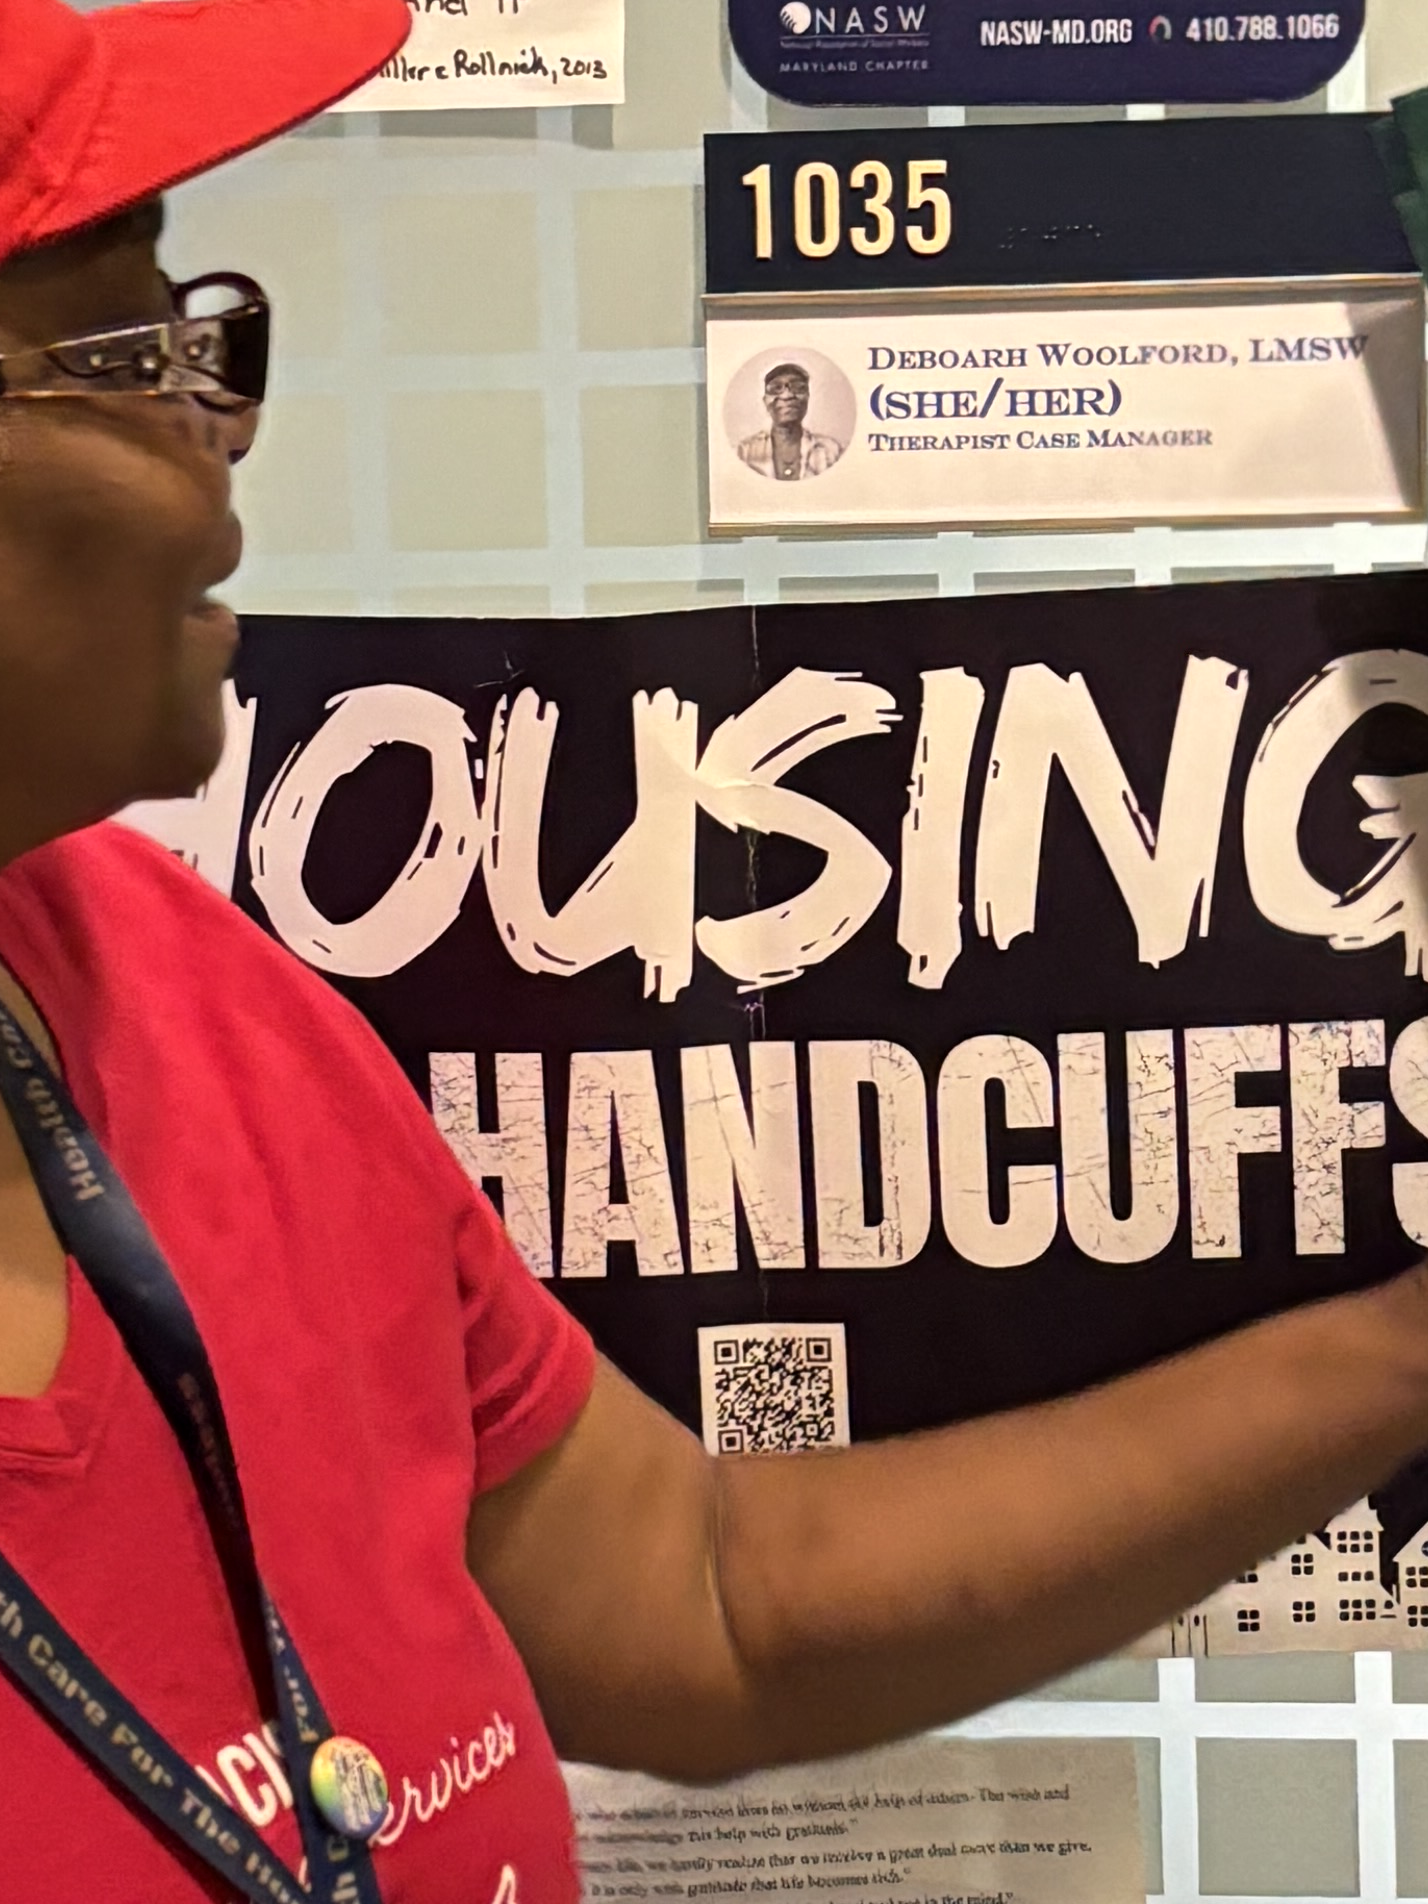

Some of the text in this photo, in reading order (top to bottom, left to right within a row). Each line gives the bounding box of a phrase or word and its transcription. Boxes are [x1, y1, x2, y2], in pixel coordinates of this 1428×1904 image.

[816, 4, 925, 34] NASW
[980, 15, 1340, 48] NASW-MD.ORG 410.788.1066
[560, 56, 607, 81] 2013
[741, 158, 954, 261] 1035
[868, 334, 1369, 371] DEBOARH WOOLFORD, LMSW
[870, 377, 1123, 422] (SHE/HER)
[868, 428, 1214, 453] THERAPIST CASE MANAGER
[28, 1632, 109, 1729] Care
[109, 1721, 174, 1789] For
[180, 1786, 241, 1857] The
